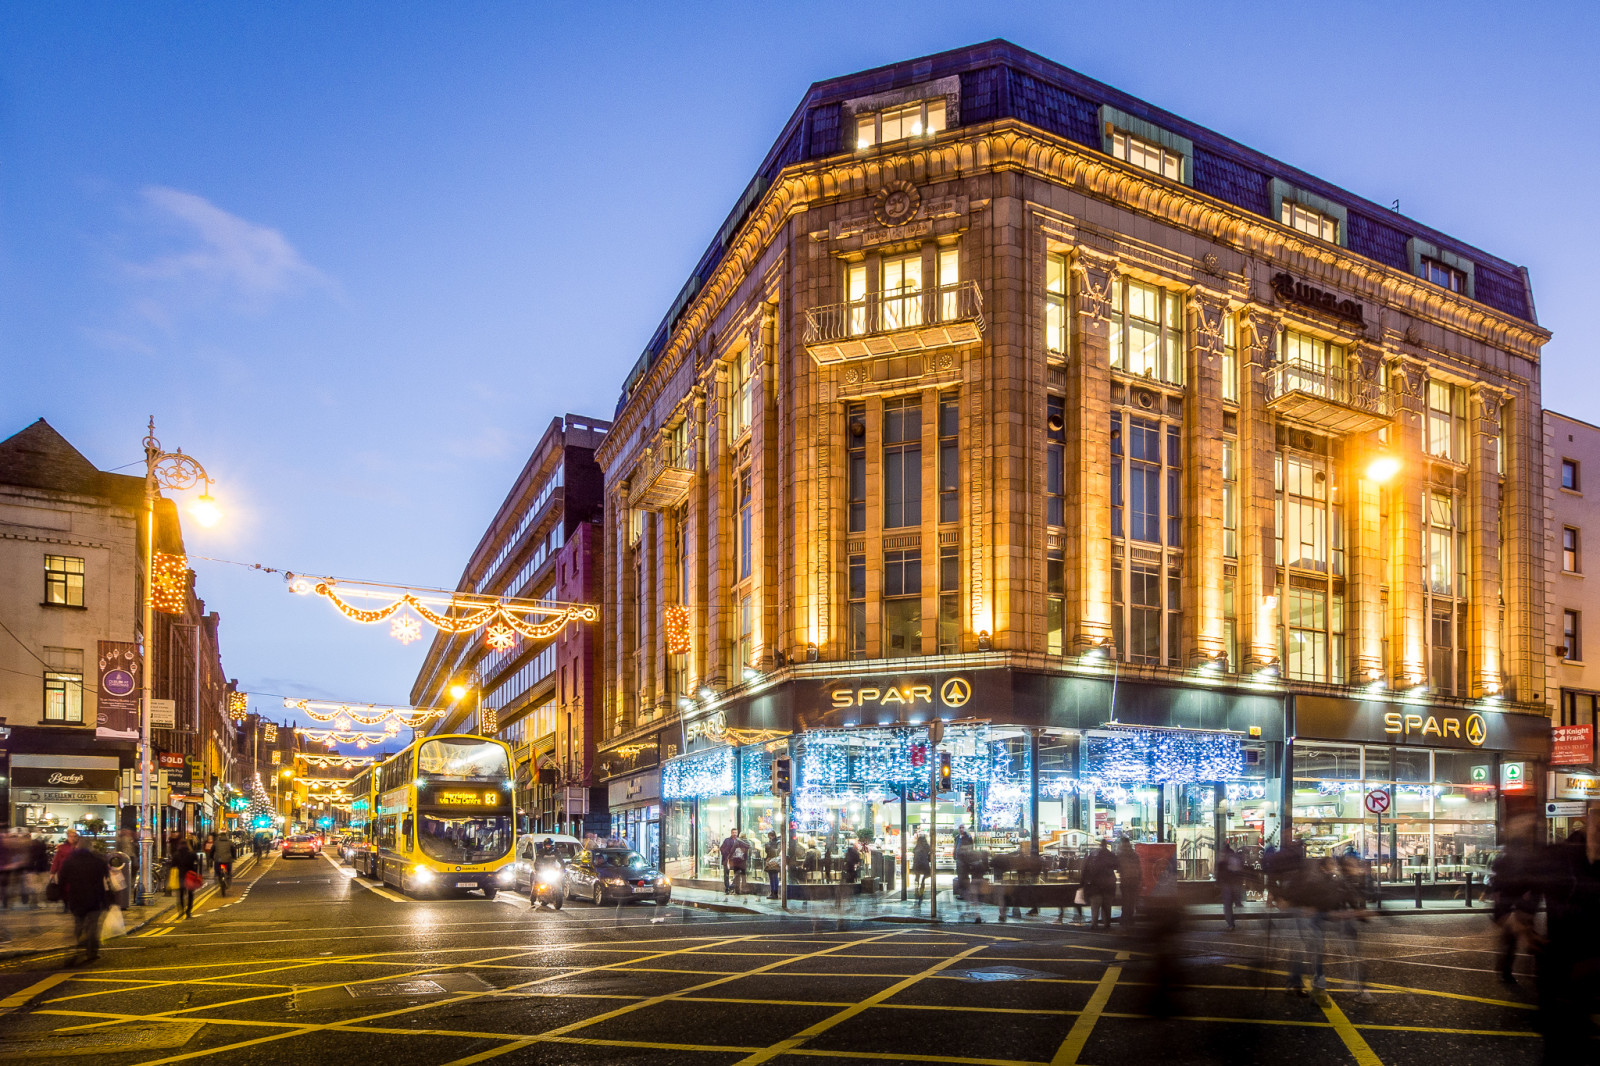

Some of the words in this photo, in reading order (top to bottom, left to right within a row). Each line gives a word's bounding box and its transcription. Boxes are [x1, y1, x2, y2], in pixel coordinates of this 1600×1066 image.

[831, 685, 933, 708] SPAR
[687, 720, 715, 741] SPAR
[1384, 712, 1460, 739] SPAR
[161, 756, 183, 764] SOLD
[47, 772, 84, 784] Bewley's
[485, 793, 496, 804] 83
